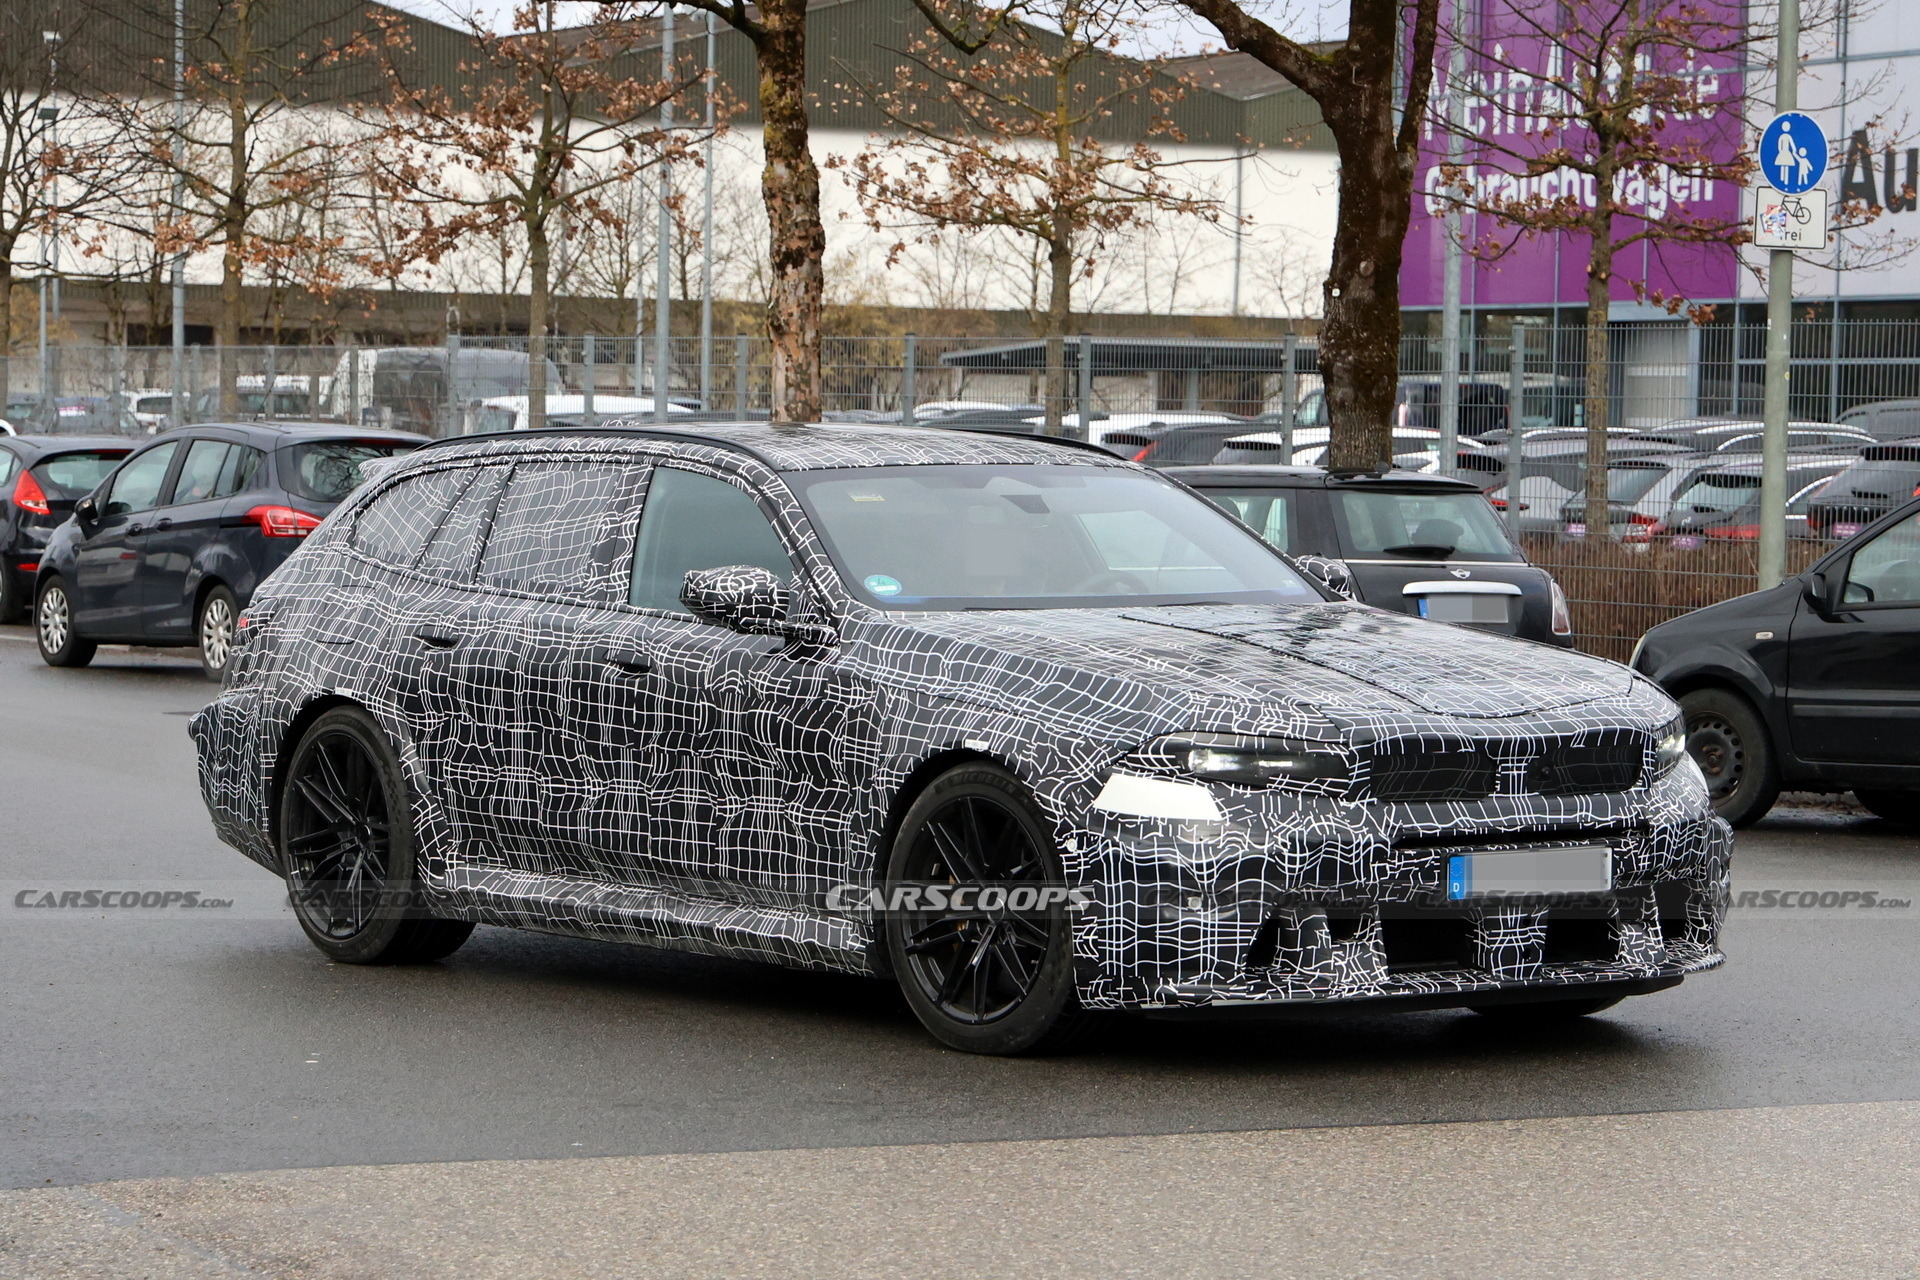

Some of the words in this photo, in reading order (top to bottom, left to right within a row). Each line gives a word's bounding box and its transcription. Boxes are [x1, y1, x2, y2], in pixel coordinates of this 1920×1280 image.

[1841, 130, 1918, 214] Au
[1425, 154, 1714, 220] Gbrauchtagen
[1780, 228, 1802, 241] rei
[952, 771, 1017, 794] MICHELIN
[1453, 882, 1460, 893] D
